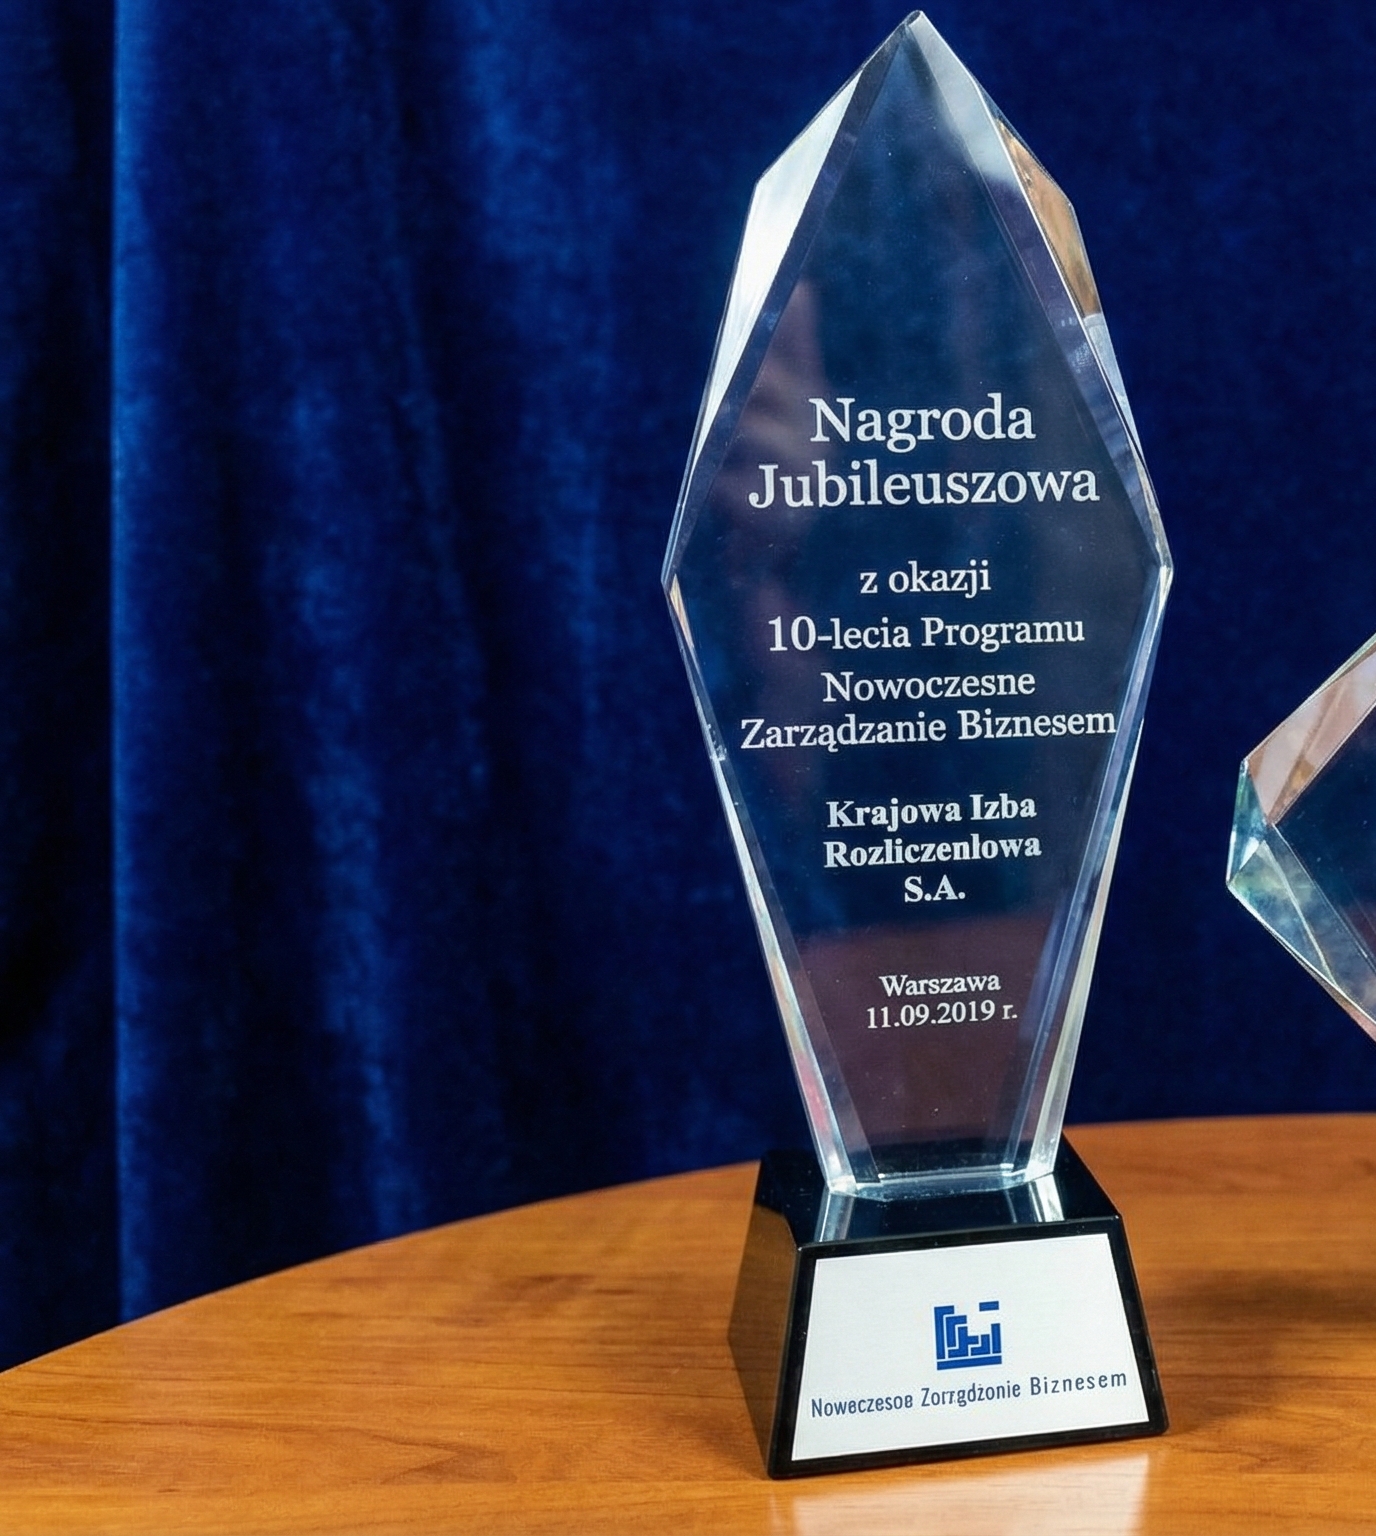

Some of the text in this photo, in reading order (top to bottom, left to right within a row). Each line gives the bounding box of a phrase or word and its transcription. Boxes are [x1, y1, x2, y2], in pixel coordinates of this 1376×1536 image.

[808, 391, 1037, 454] Nagroda
[747, 459, 1101, 510] Jubileuszowa
[859, 560, 992, 600] z okazji
[767, 614, 1086, 653] 10-lecia Programu
[820, 670, 1036, 703] Nowoczesne
[740, 707, 1117, 752] Zarządzanie Biznesem
[825, 793, 1037, 832] Krajowa Izba
[903, 874, 966, 903] S.A.
[880, 974, 1002, 998] Warszawa
[866, 1000, 1018, 1030] 11.09.2019 r.
[1030, 1371, 1127, 1396] Biznesem
